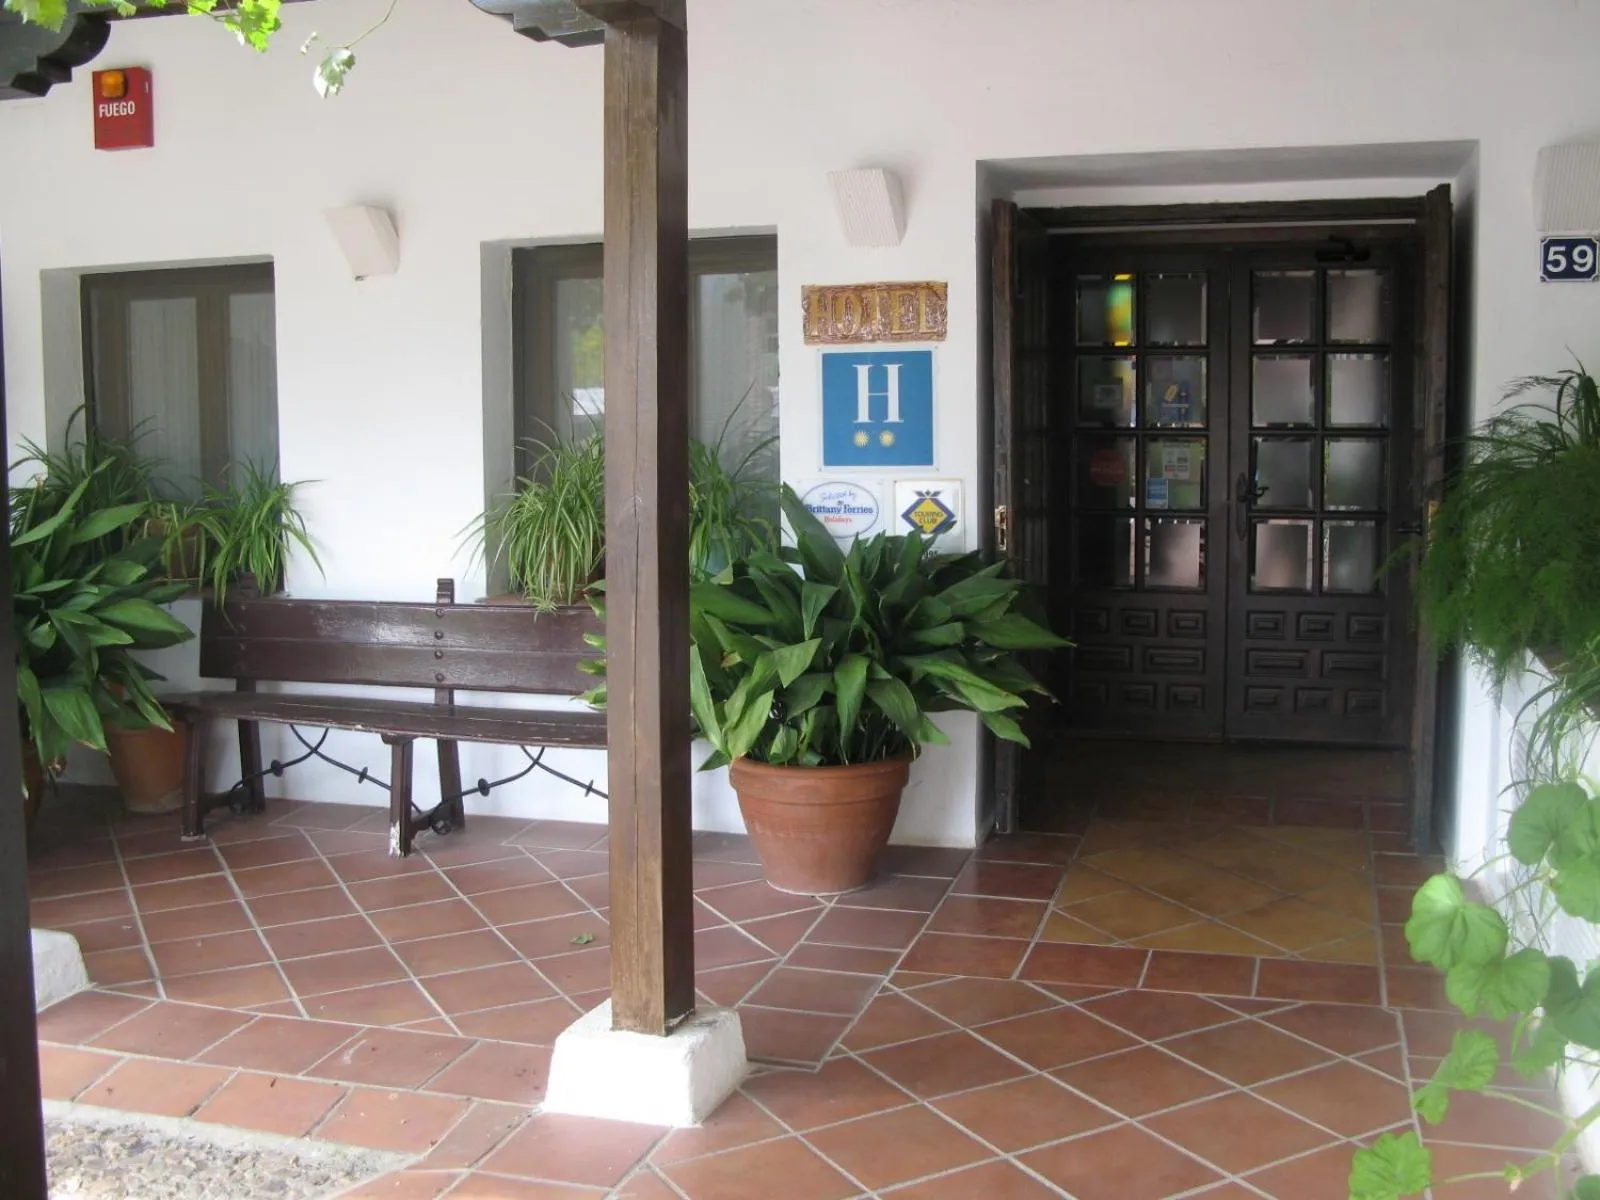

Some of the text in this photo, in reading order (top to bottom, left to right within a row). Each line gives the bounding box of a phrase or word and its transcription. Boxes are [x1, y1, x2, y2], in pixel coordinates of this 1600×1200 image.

[98, 100, 136, 118] FUEGO
[1546, 245, 1594, 273] 59
[851, 363, 905, 424] H
[843, 503, 874, 514] Ferries
